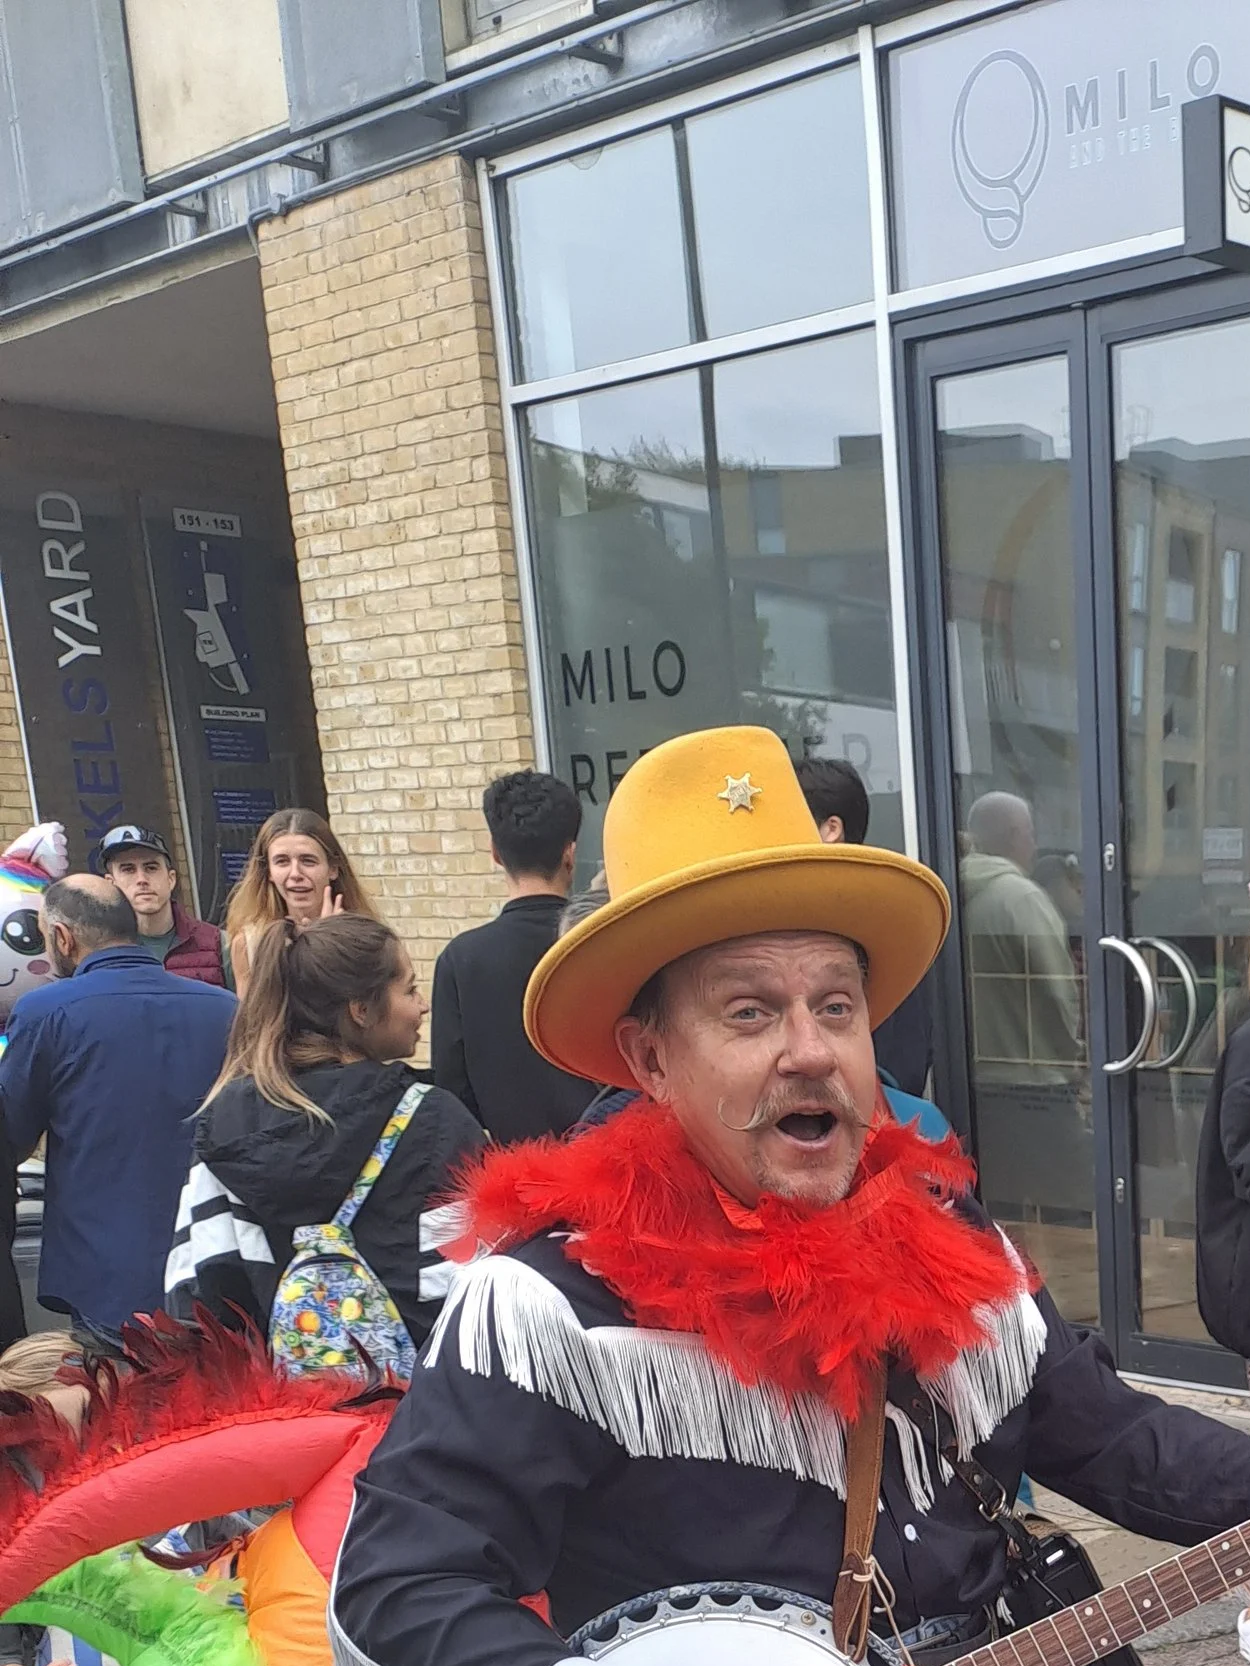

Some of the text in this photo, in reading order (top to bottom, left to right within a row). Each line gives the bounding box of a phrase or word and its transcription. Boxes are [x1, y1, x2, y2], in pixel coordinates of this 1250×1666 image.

[1065, 43, 1220, 137] MILO
[1117, 124, 1151, 155] THE
[179, 514, 201, 527] 151
[213, 518, 235, 531] 153
[36, 490, 103, 670] YARD
[560, 640, 687, 707] MILO
[205, 708, 261, 719] BUILDING PLAN
